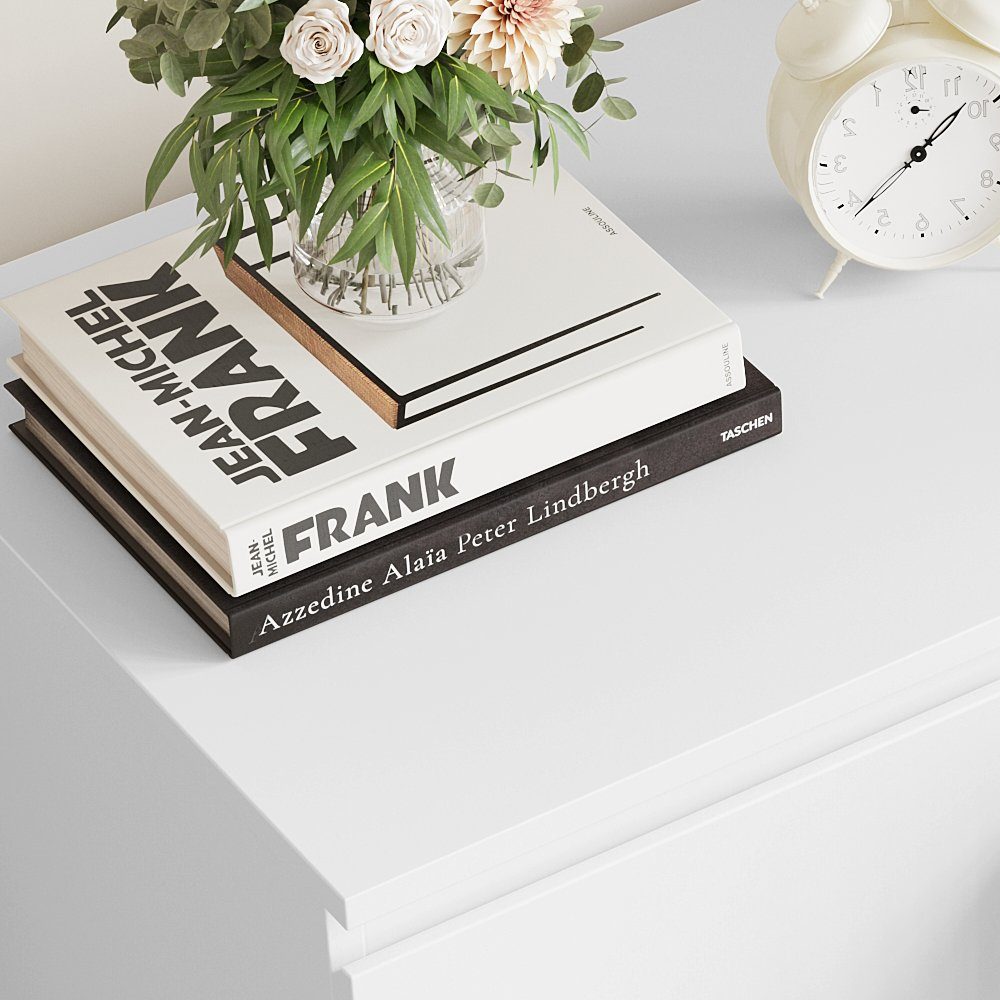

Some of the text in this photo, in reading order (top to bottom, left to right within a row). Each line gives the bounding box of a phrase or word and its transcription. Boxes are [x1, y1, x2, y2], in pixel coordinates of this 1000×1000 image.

[582, 206, 618, 236] ASSOULINE
[65, 289, 283, 485] JEAN-MICHEL
[98, 261, 358, 477] FRANK
[721, 342, 733, 388] ASSOULINE
[720, 412, 774, 443] TASCHEN
[258, 459, 651, 636] Azzedine Alaïa Peter Lindbergh
[281, 457, 460, 565] FRANK
[262, 528, 279, 577] MICHEL
